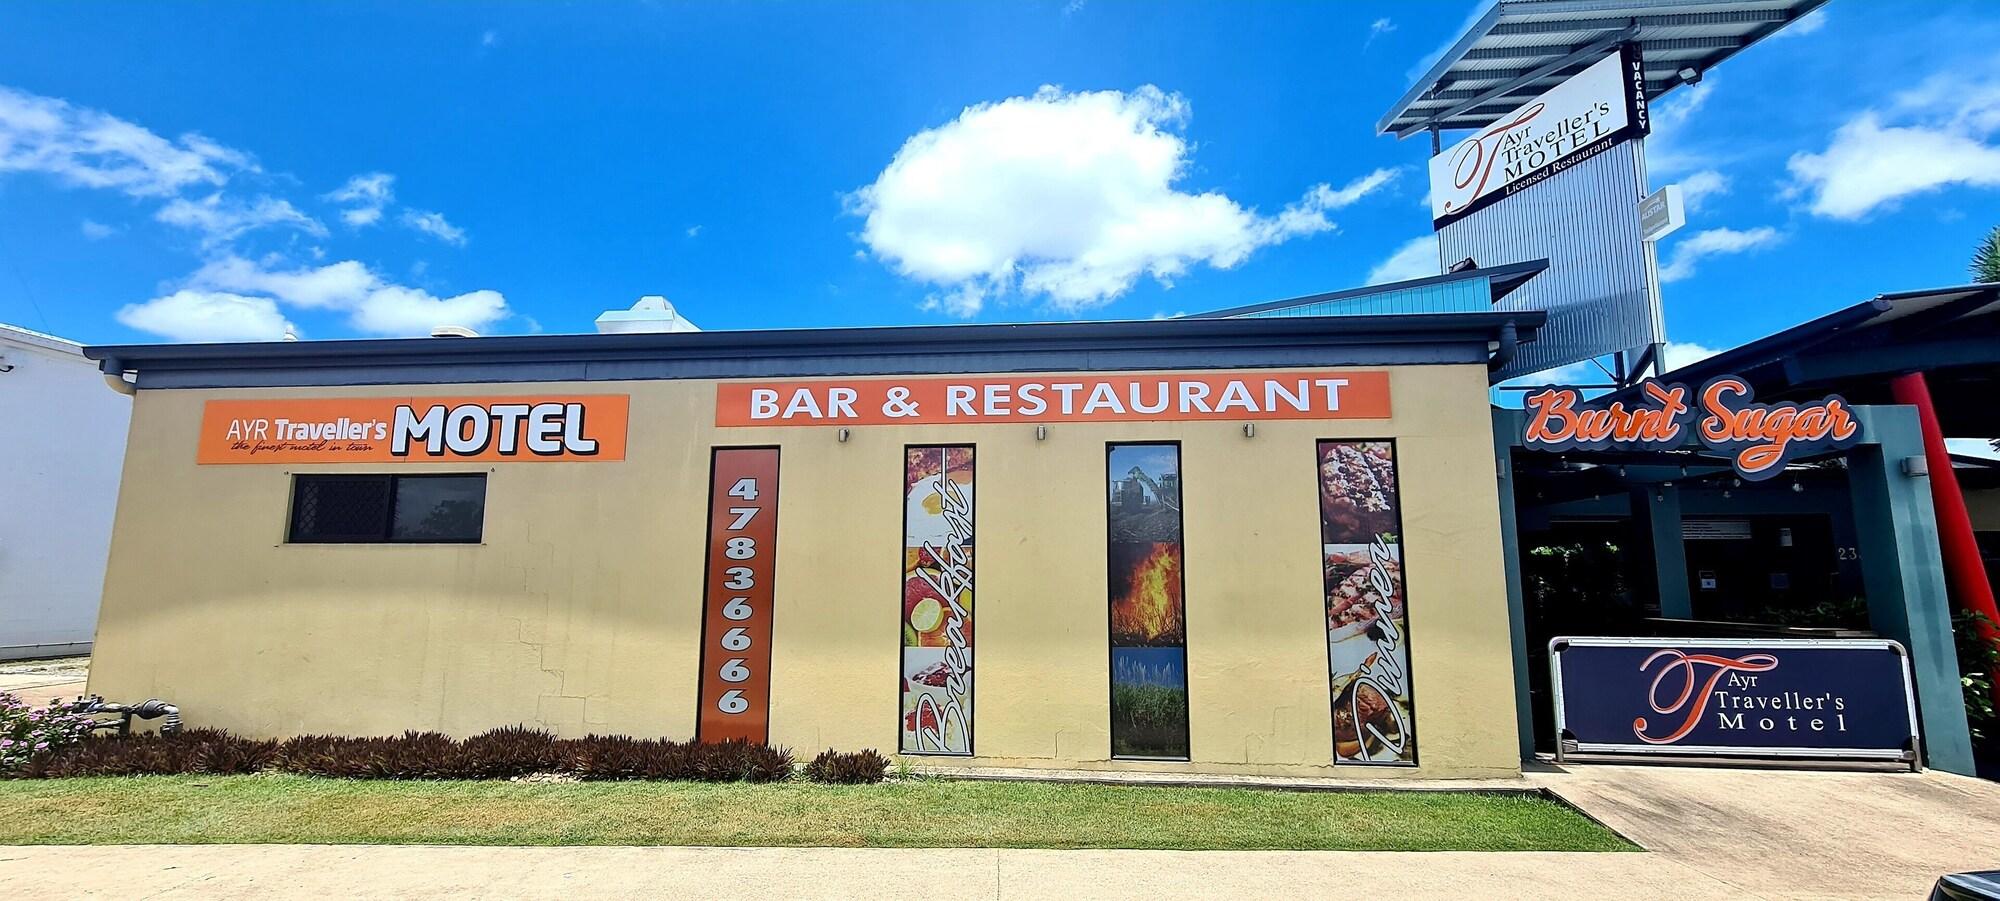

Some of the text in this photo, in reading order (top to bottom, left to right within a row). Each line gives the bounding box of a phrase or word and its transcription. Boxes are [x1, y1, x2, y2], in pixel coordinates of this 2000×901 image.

[1632, 61, 1647, 129] VACANCY
[1501, 102, 1610, 165] Traveller's
[1503, 126, 1532, 149] Ayr
[1504, 120, 1610, 182] MOTEL
[1505, 137, 1614, 195] Licensed Restaurant
[750, 378, 1349, 419] BAR & RESTAURANT
[1527, 379, 1857, 472] Burnt Sugar
[226, 403, 599, 456] AYR Traveller's MOTEL
[231, 440, 374, 455] the finest motel in town
[717, 477, 761, 714] 47836666
[916, 447, 973, 752] Breakfast
[1352, 532, 1406, 763] Dinner
[1715, 691, 1845, 711] Traveller's
[1728, 672, 1758, 691] Ayr
[1718, 712, 1847, 732] Motel
